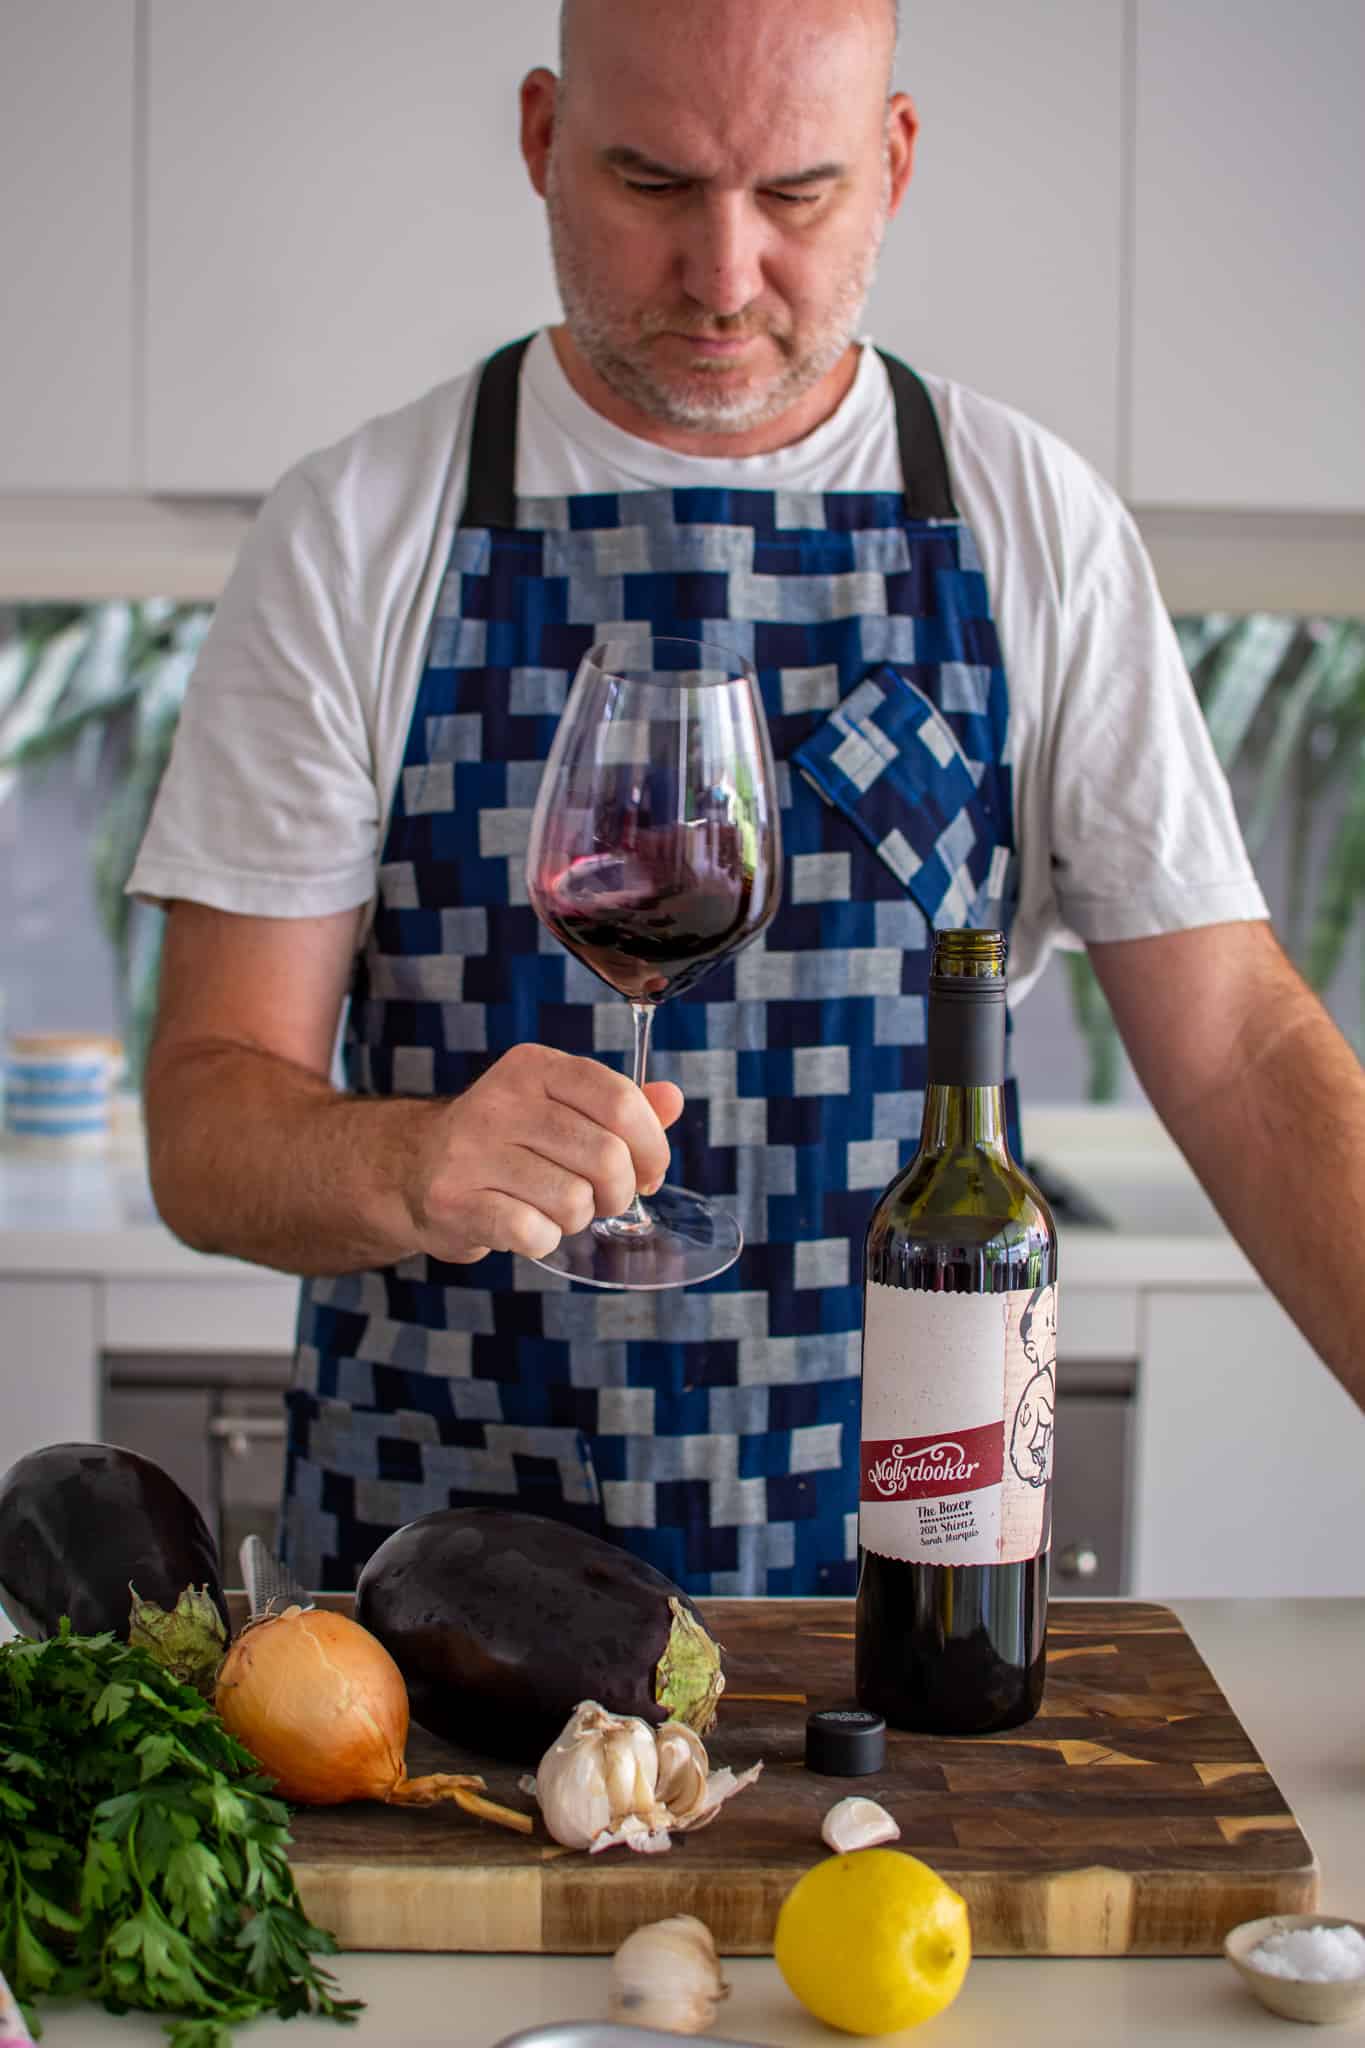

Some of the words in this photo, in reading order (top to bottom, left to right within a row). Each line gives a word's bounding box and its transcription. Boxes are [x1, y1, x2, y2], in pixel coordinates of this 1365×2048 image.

[916, 1506, 936, 1518] The
[938, 1500, 972, 1515] Boxer
[920, 1525, 938, 1535] 2021
[941, 1518, 976, 1531] Shiraz
[920, 1537, 943, 1546] Sarah
[945, 1529, 980, 1543] Marquis
